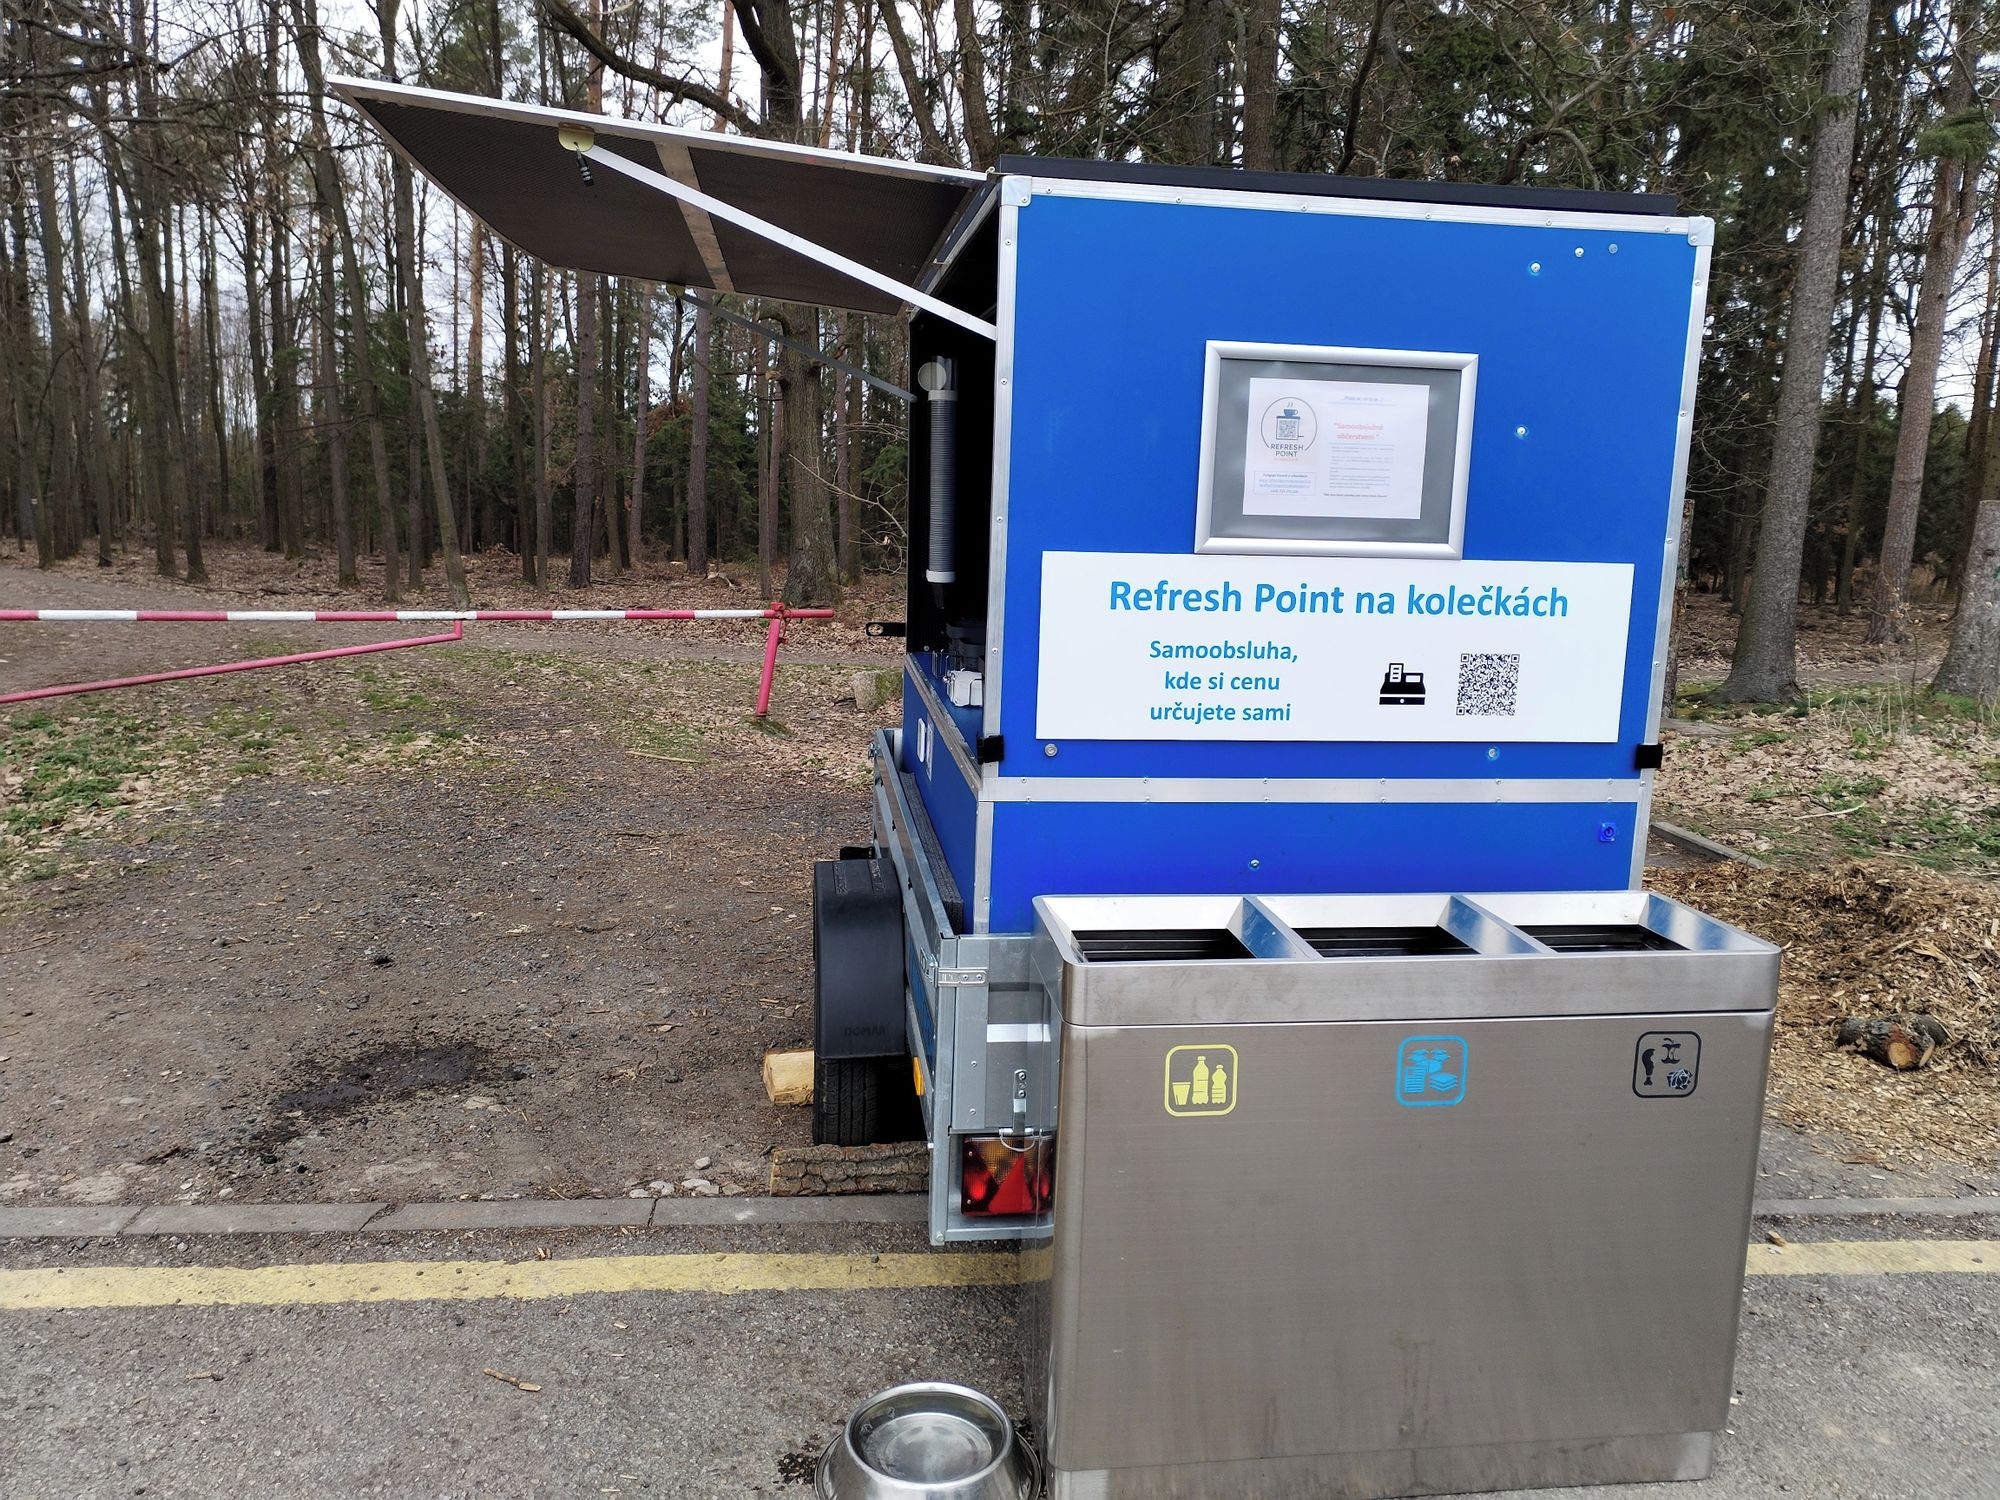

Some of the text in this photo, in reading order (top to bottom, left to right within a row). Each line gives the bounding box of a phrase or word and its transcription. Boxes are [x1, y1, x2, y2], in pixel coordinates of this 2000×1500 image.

[1270, 443, 1304, 451] REFRESH
[1109, 580, 1569, 618] Refresh Point na kolečkách
[1149, 640, 1298, 664] Samoobsluha,
[1164, 671, 1281, 691] kde si cenu
[1150, 702, 1292, 725] určujete sami
